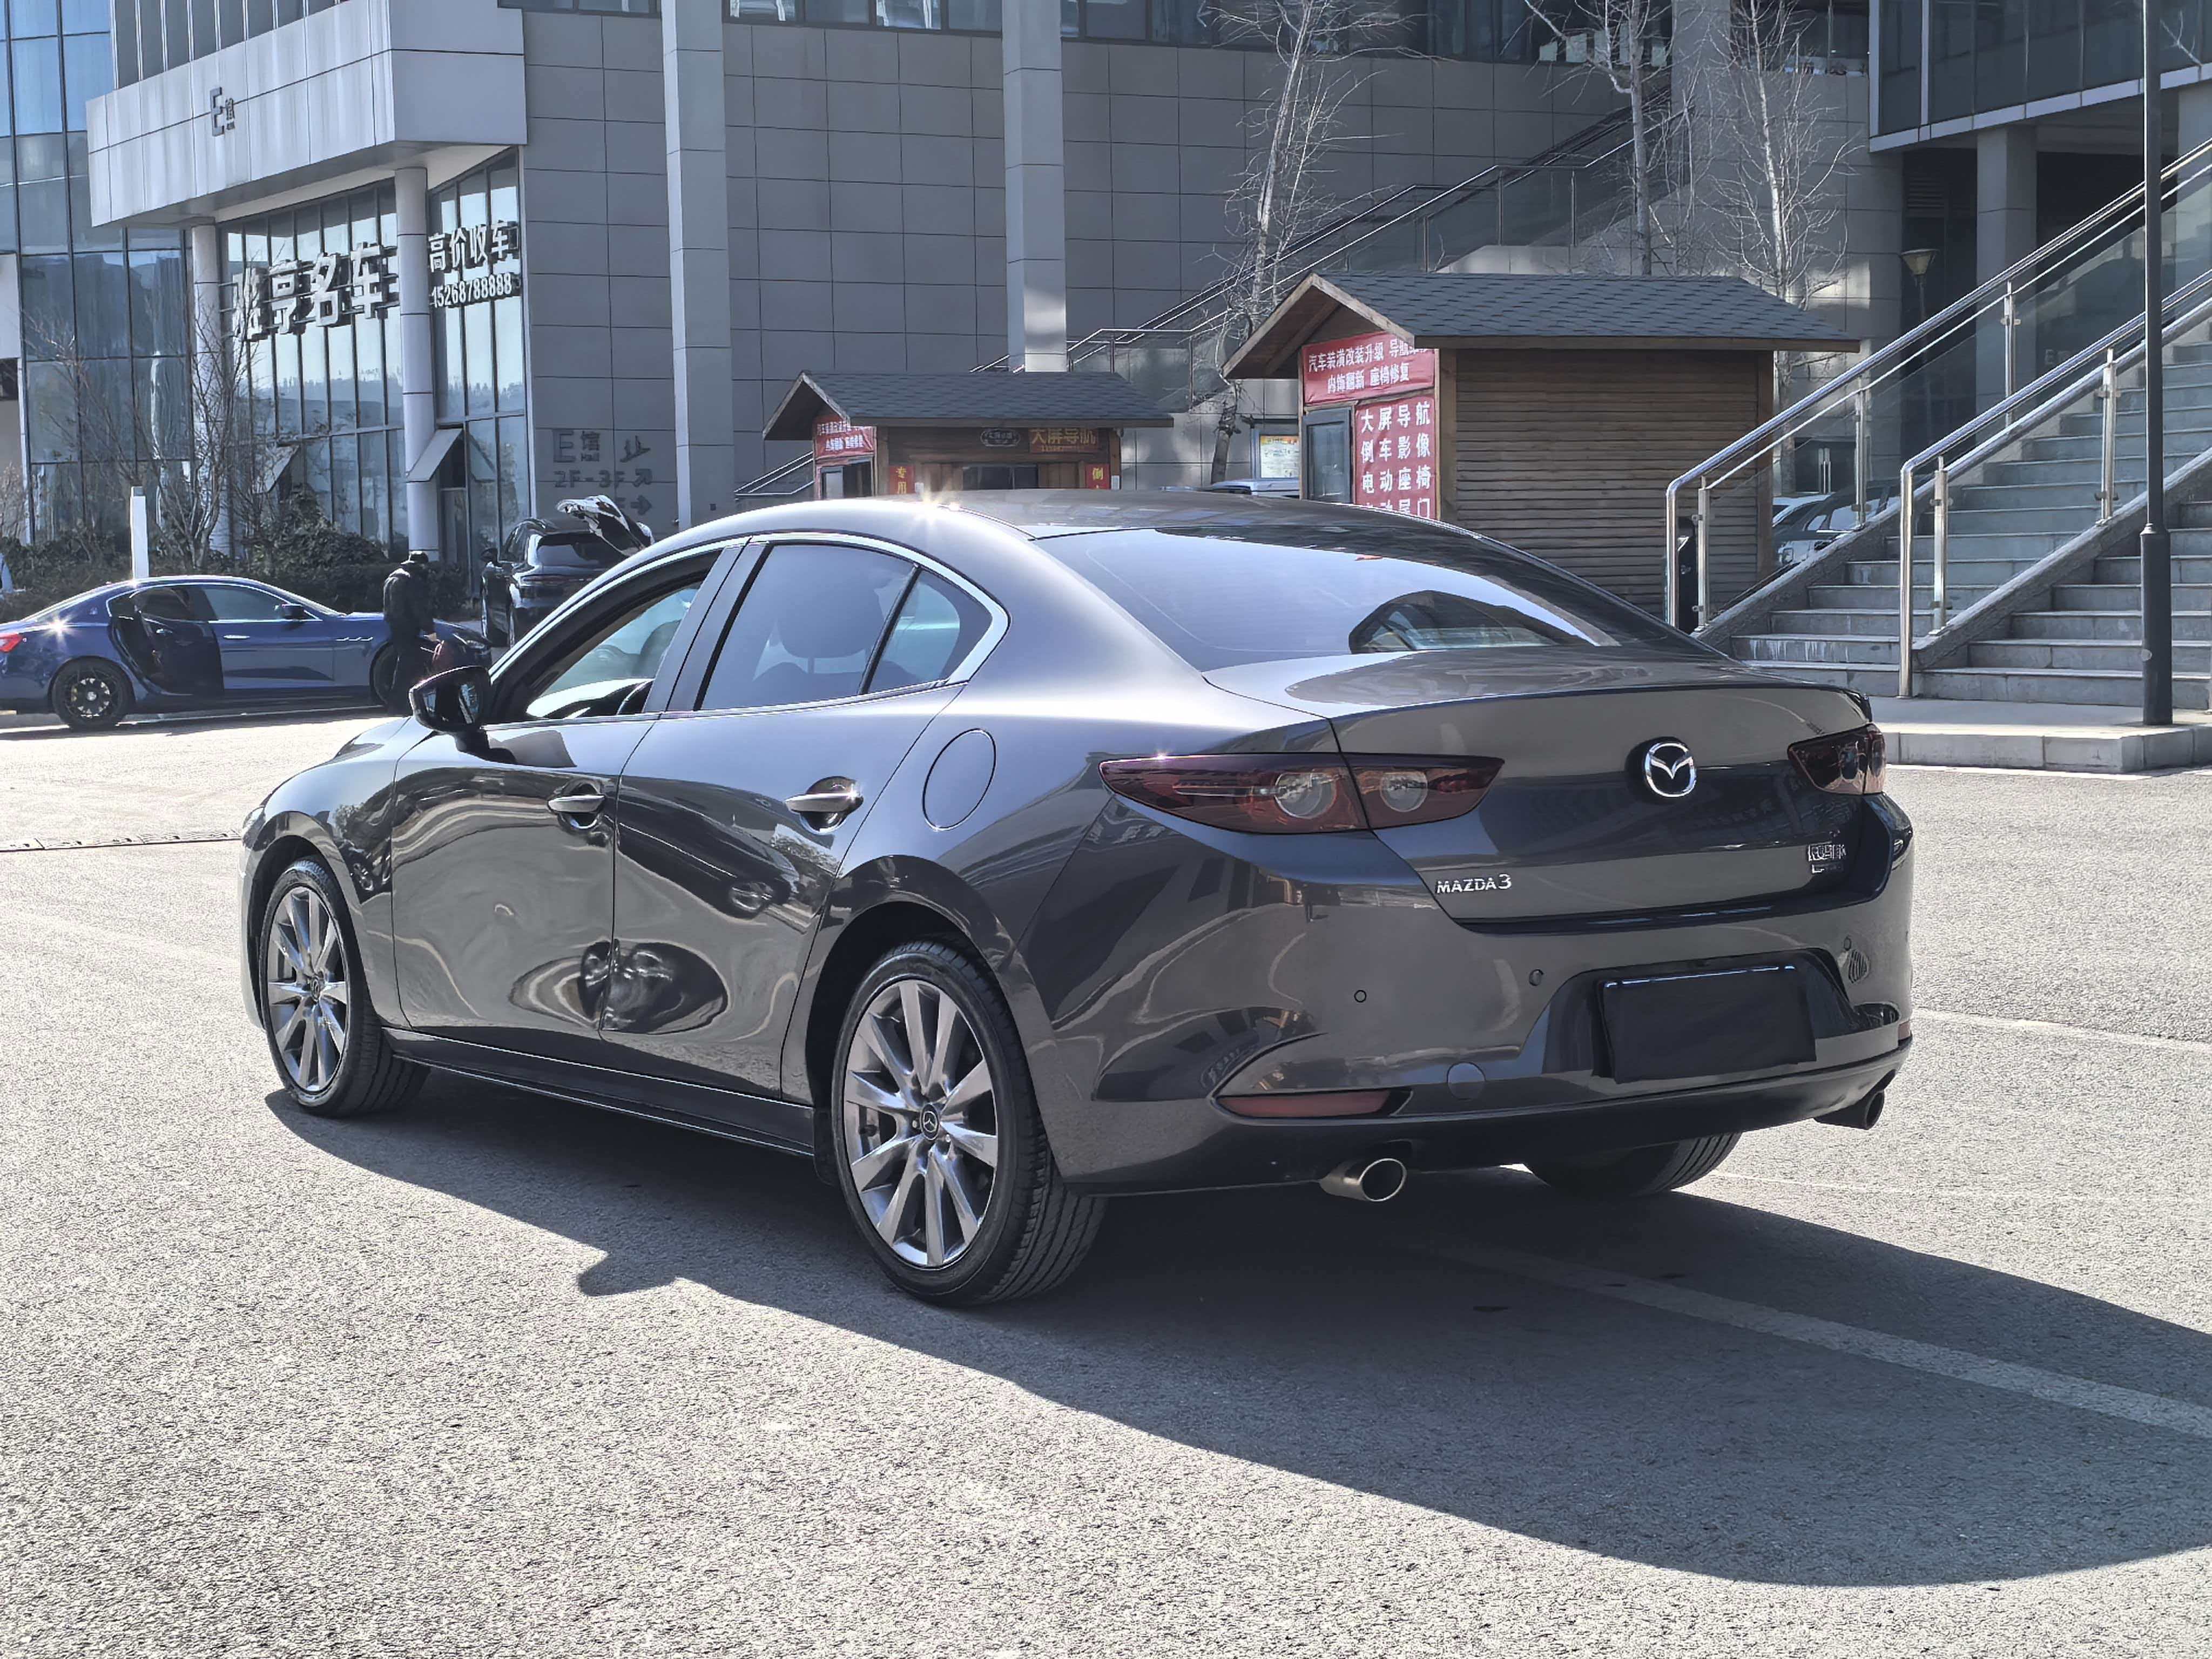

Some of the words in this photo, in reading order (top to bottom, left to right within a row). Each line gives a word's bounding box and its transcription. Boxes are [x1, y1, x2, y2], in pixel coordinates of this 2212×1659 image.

[428, 222, 509, 272] 高价收车
[432, 273, 512, 308] 15268788888
[1361, 401, 1431, 433] 大屏导航
[1360, 433, 1431, 463] 倒车影像
[554, 469, 626, 488] 2F-3F
[1362, 464, 1431, 494] 电动座椅
